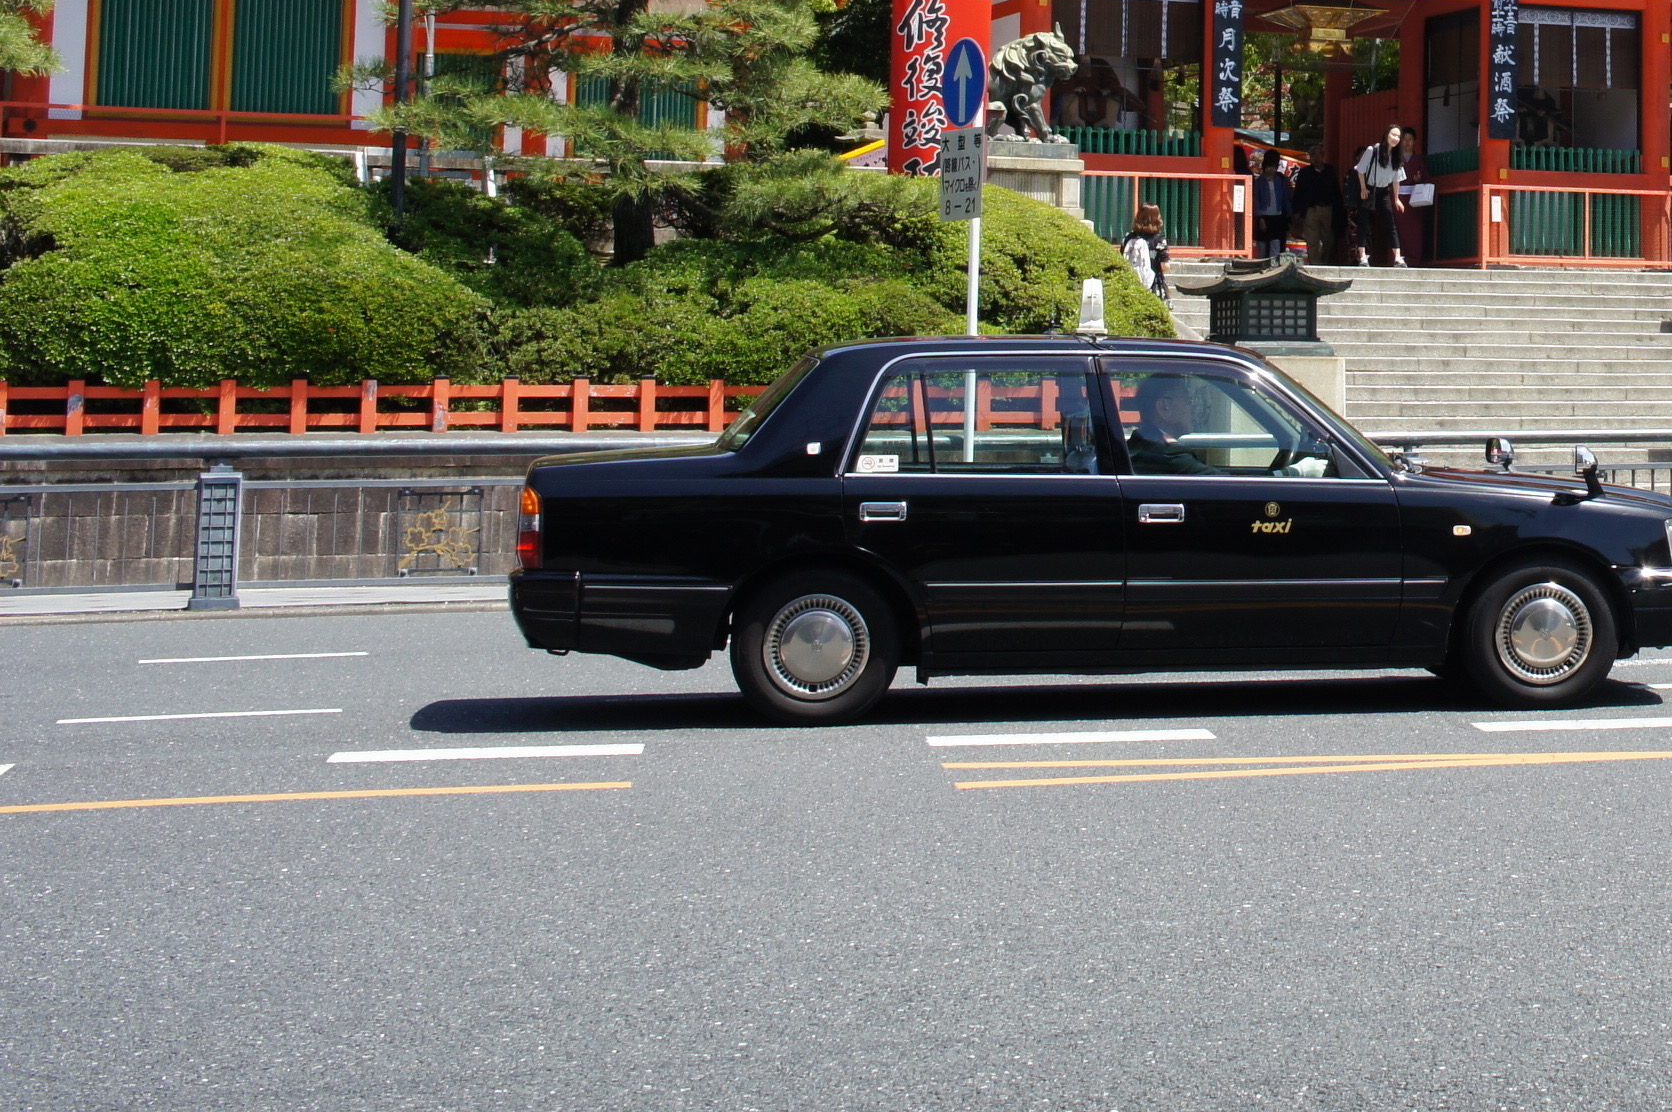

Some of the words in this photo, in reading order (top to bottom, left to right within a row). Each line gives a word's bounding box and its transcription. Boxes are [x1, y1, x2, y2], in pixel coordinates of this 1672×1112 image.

[1214, 28, 1239, 113] 月次祭
[1490, 44, 1516, 124] 献酒祭
[941, 133, 982, 153] 大型等
[1251, 518, 1293, 533] taxi
